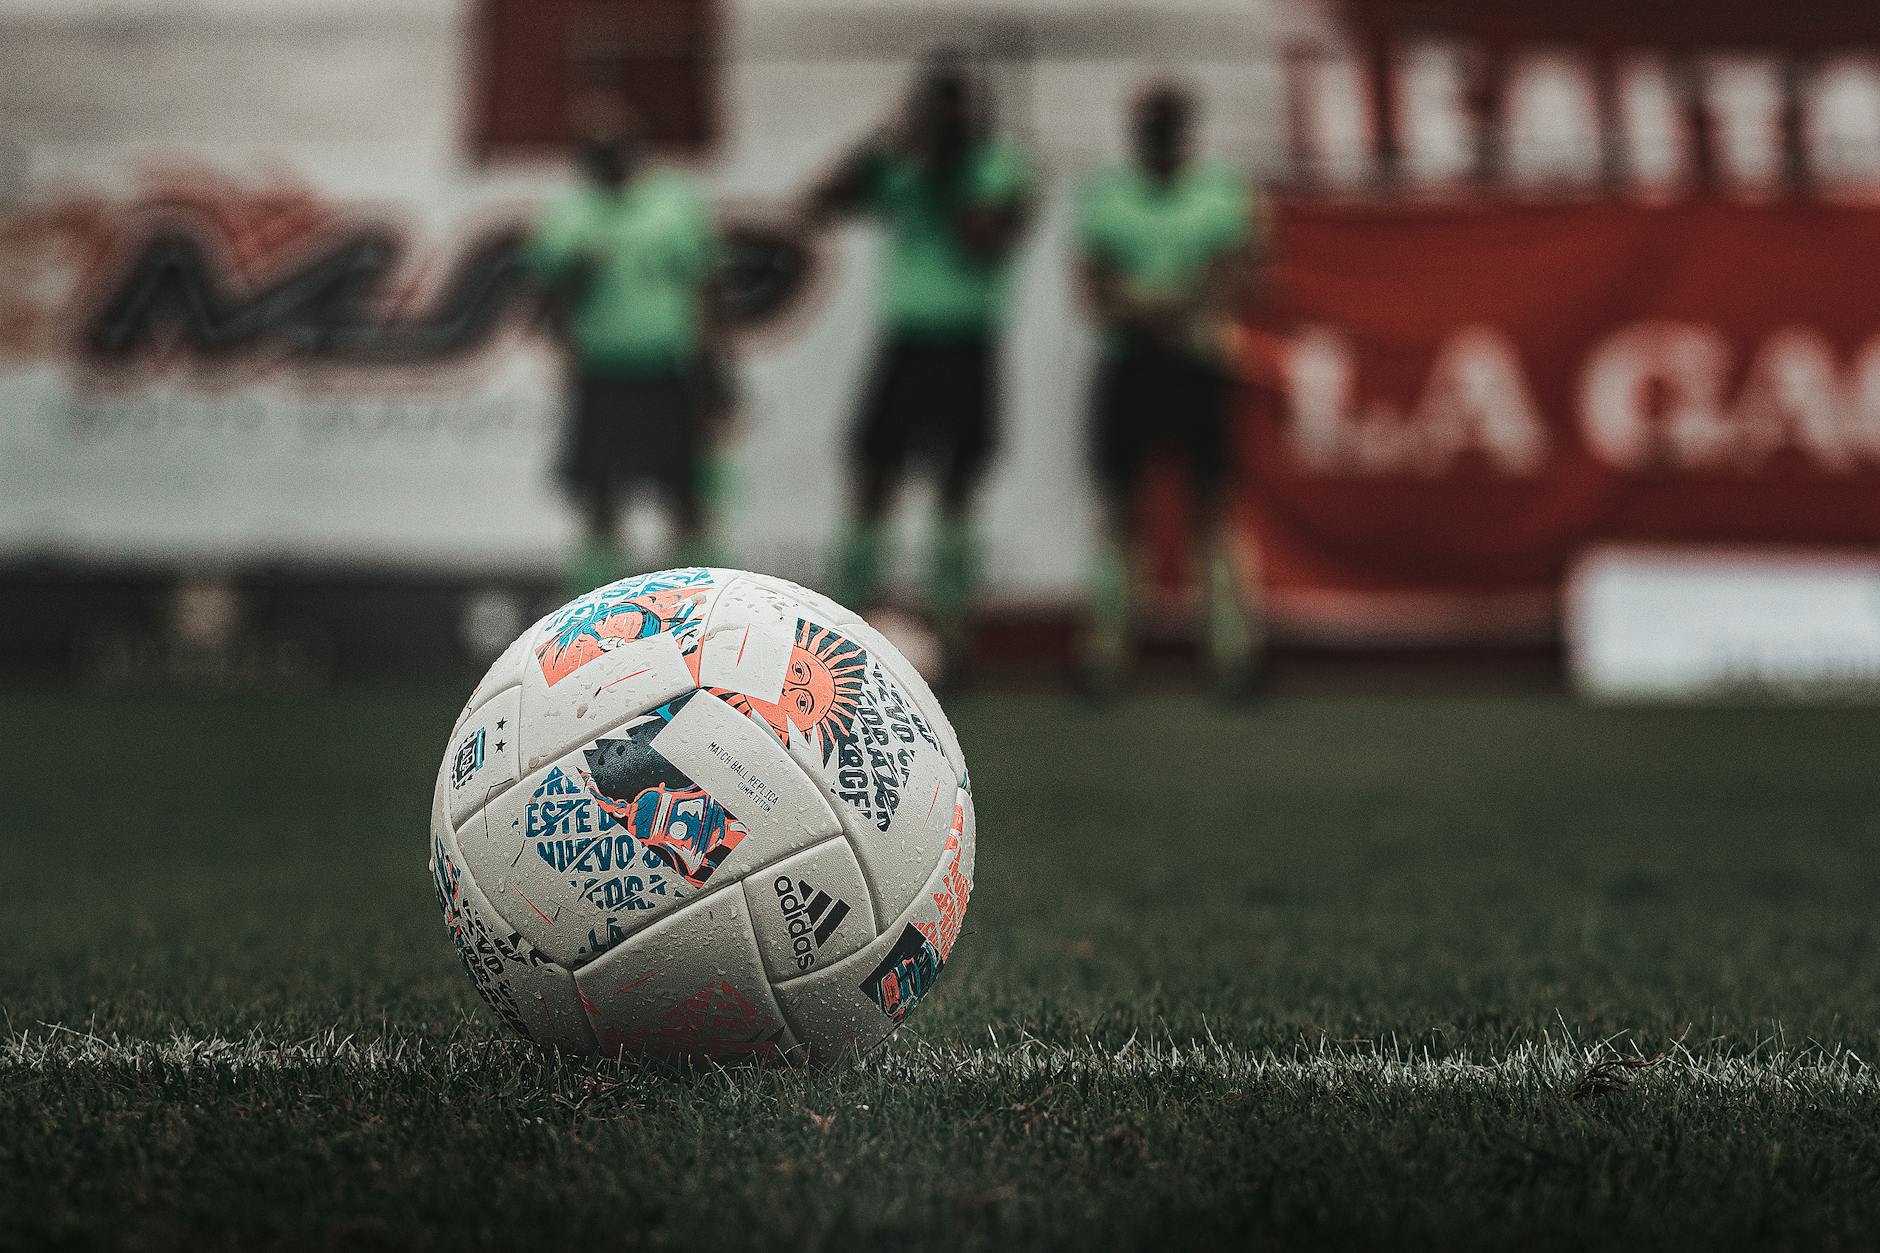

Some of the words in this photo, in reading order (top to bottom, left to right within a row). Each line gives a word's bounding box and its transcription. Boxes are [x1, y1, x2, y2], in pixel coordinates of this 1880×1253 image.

[1579, 320, 1880, 475] GA
[707, 741, 734, 765] MATCH
[730, 760, 749, 780] BALL
[747, 775, 779, 805] REPLICA
[738, 781, 772, 813] COMPETITION
[525, 799, 592, 838] ESTE
[536, 834, 636, 874] NUEVO
[774, 875, 815, 970] adidas
